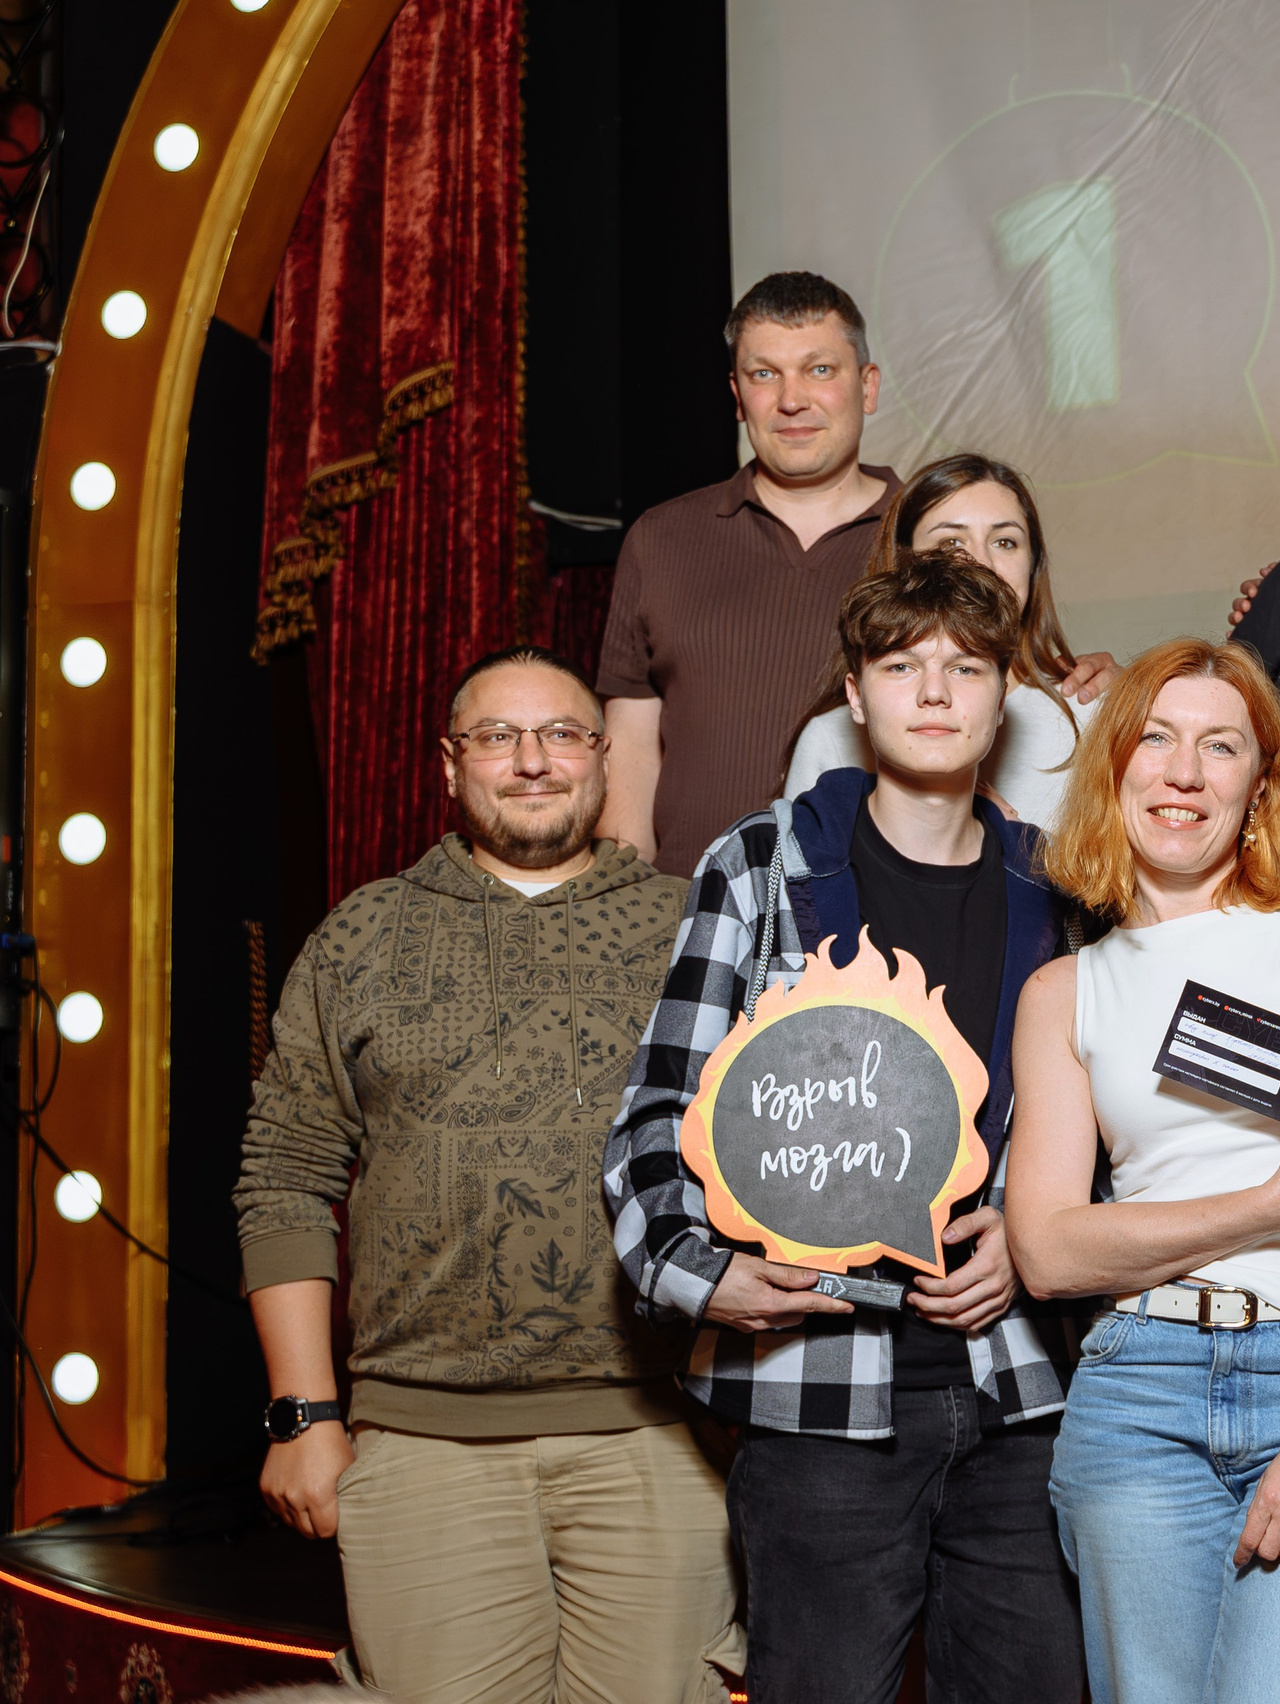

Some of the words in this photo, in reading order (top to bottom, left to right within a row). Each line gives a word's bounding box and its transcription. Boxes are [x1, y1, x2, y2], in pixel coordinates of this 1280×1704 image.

[1183, 1010, 1206, 1023] ВЫДАН
[1174, 1033, 1196, 1046] СУММА
[751, 1040, 882, 1131] Взрыв
